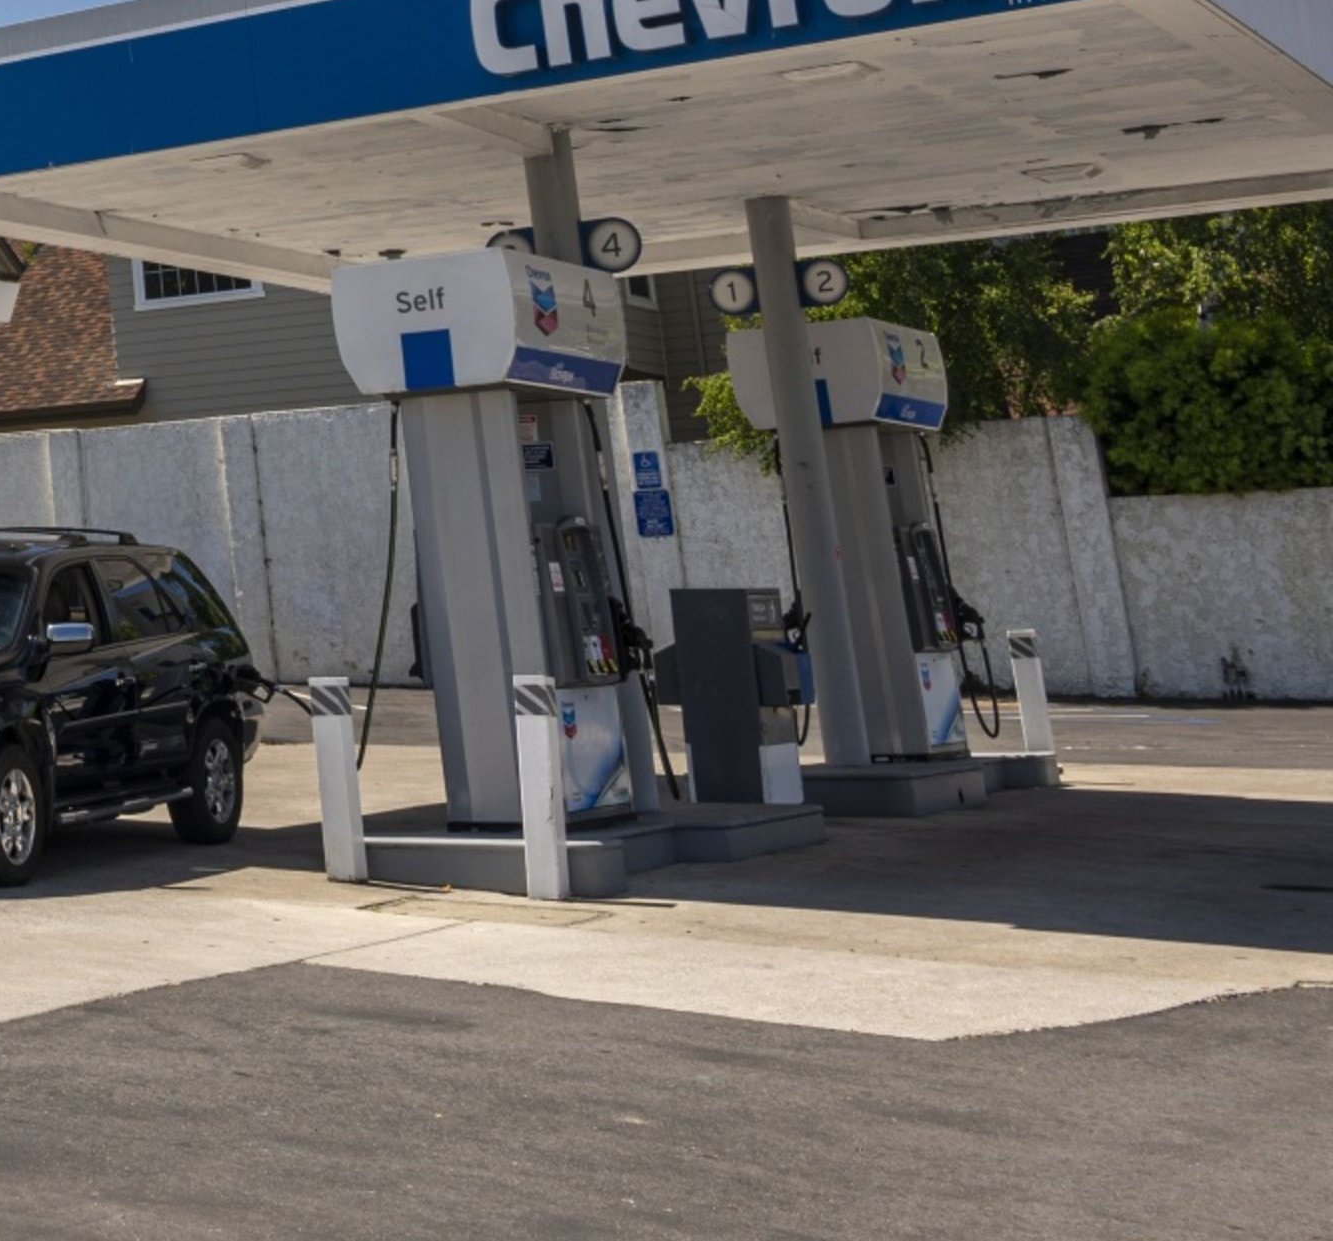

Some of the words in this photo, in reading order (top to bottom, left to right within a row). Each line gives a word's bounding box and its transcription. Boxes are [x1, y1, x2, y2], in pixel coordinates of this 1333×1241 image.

[600, 231, 622, 258] 4
[725, 281, 738, 303] 1
[817, 270, 835, 294] 2
[395, 286, 445, 314] Self
[582, 278, 598, 318] 4
